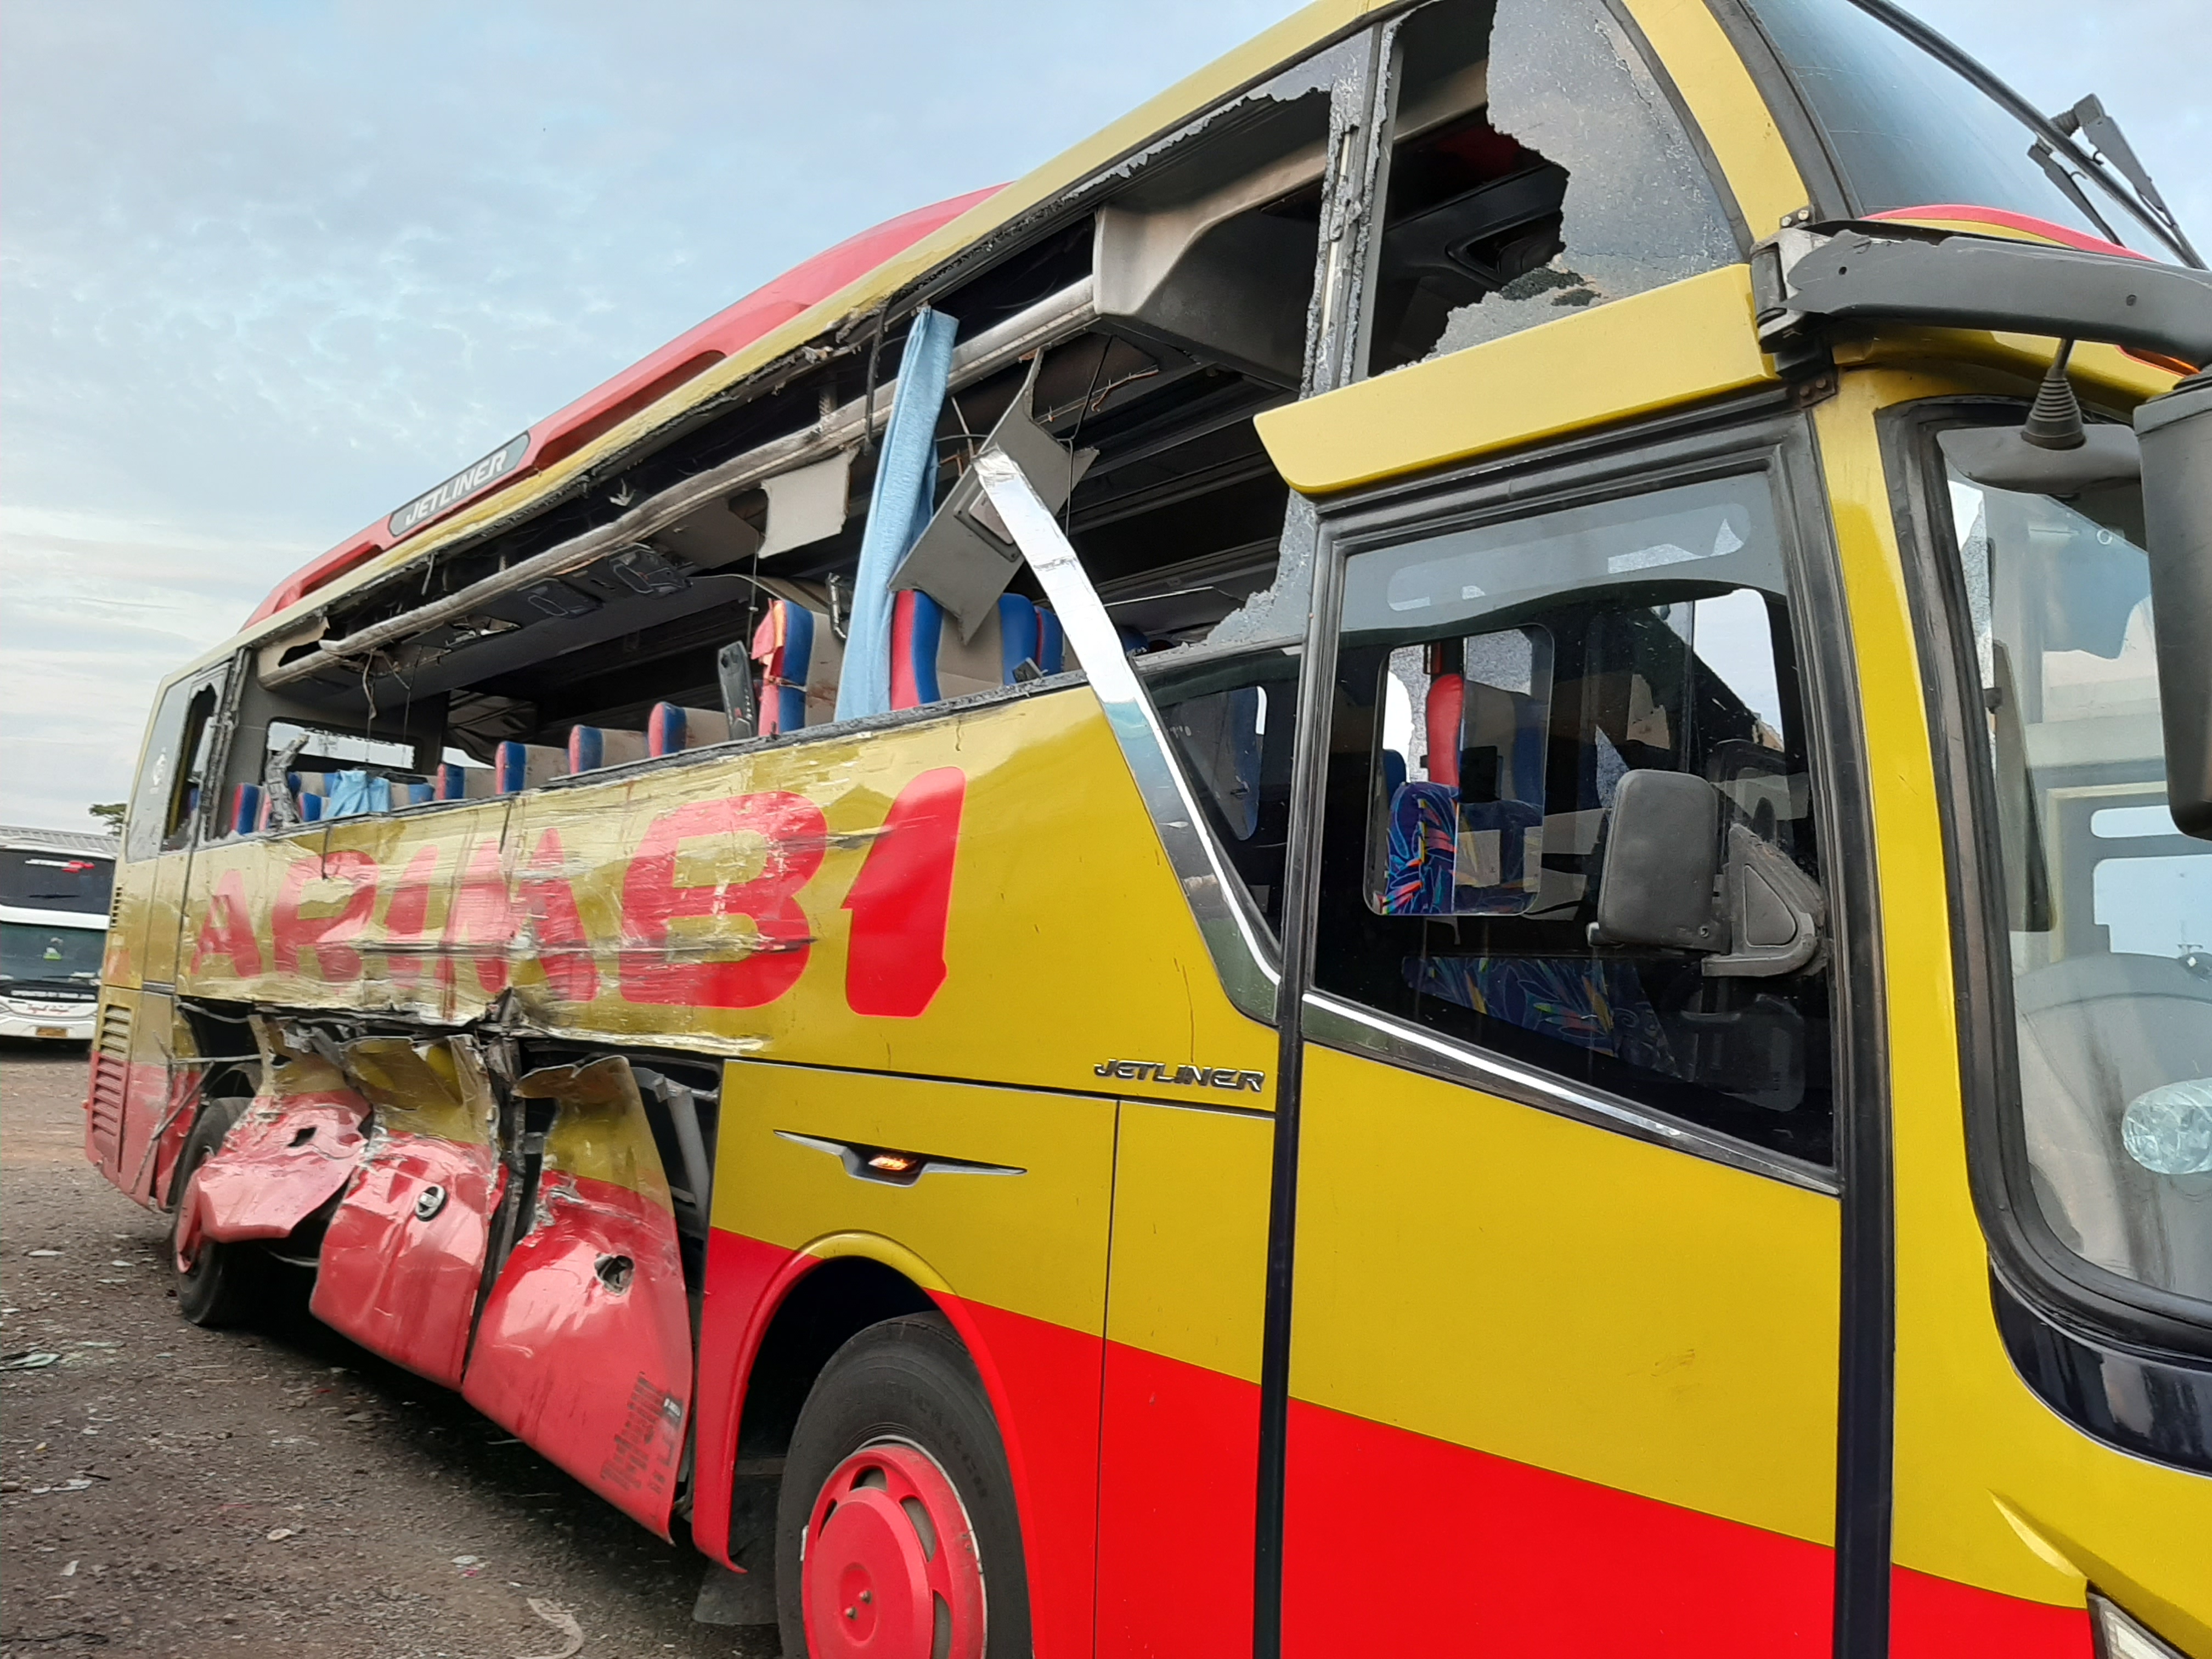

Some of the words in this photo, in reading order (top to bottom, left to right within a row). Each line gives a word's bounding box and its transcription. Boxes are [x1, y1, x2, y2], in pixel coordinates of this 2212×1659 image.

[405, 449, 507, 525] JETLINER
[190, 766, 967, 1017] ARIMBI
[1094, 1058, 1266, 1092] JETLINER
